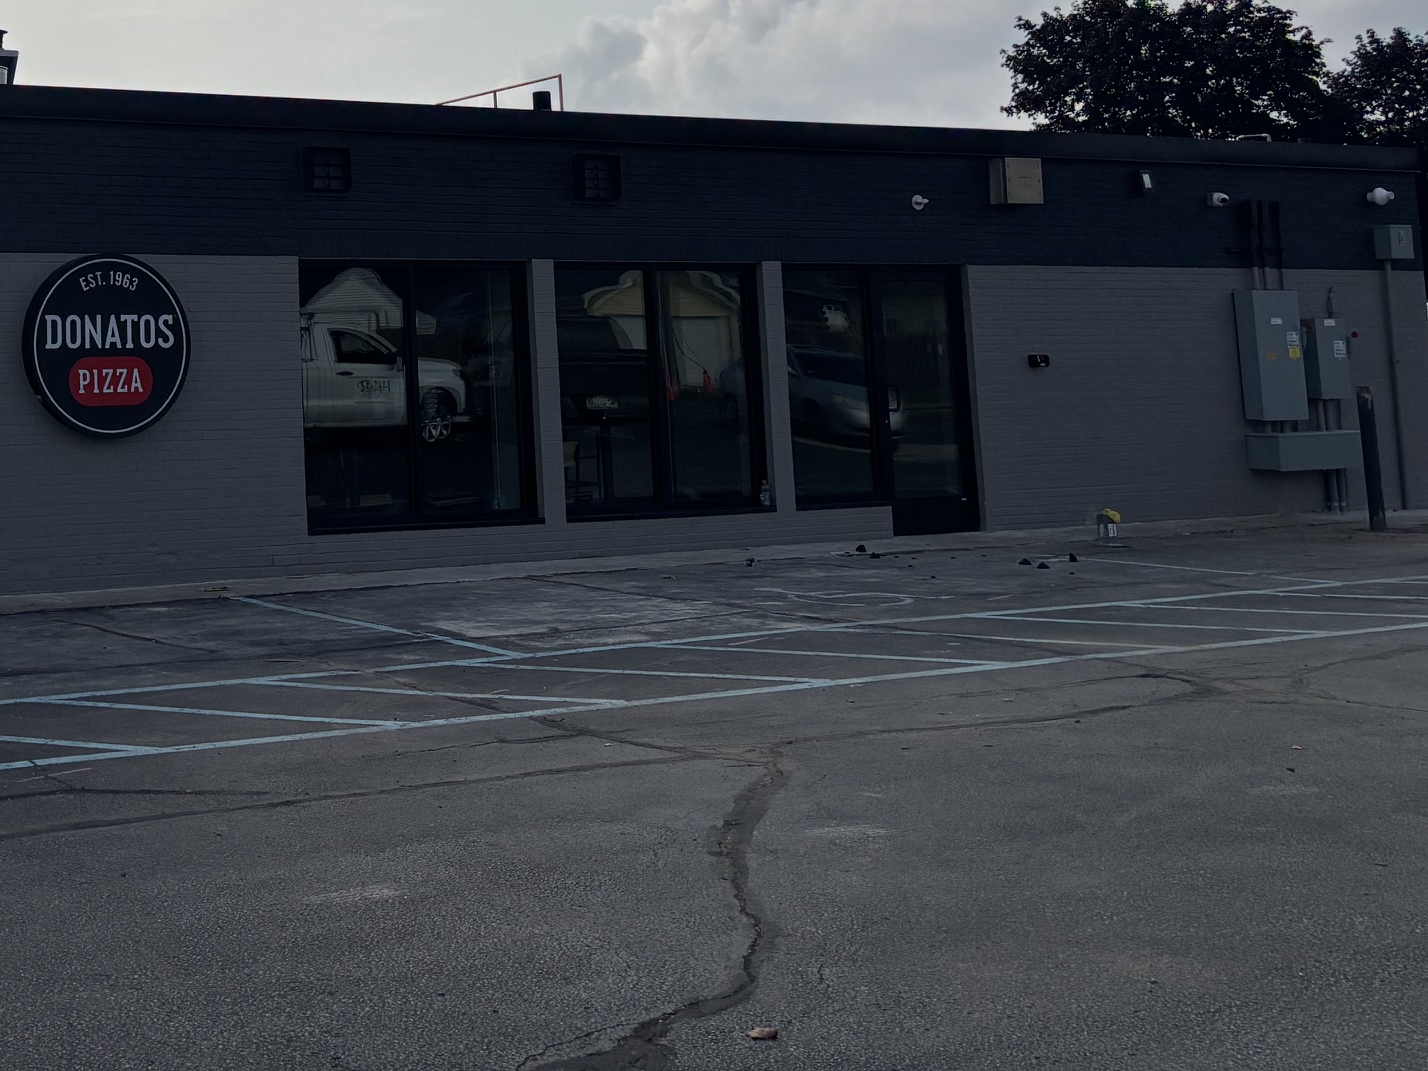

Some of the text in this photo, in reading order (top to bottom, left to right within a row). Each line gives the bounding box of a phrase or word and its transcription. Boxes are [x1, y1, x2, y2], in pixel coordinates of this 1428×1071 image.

[79, 271, 138, 291] EST. 1963
[44, 314, 175, 349] DONATOS
[78, 368, 143, 393] PIZZA
